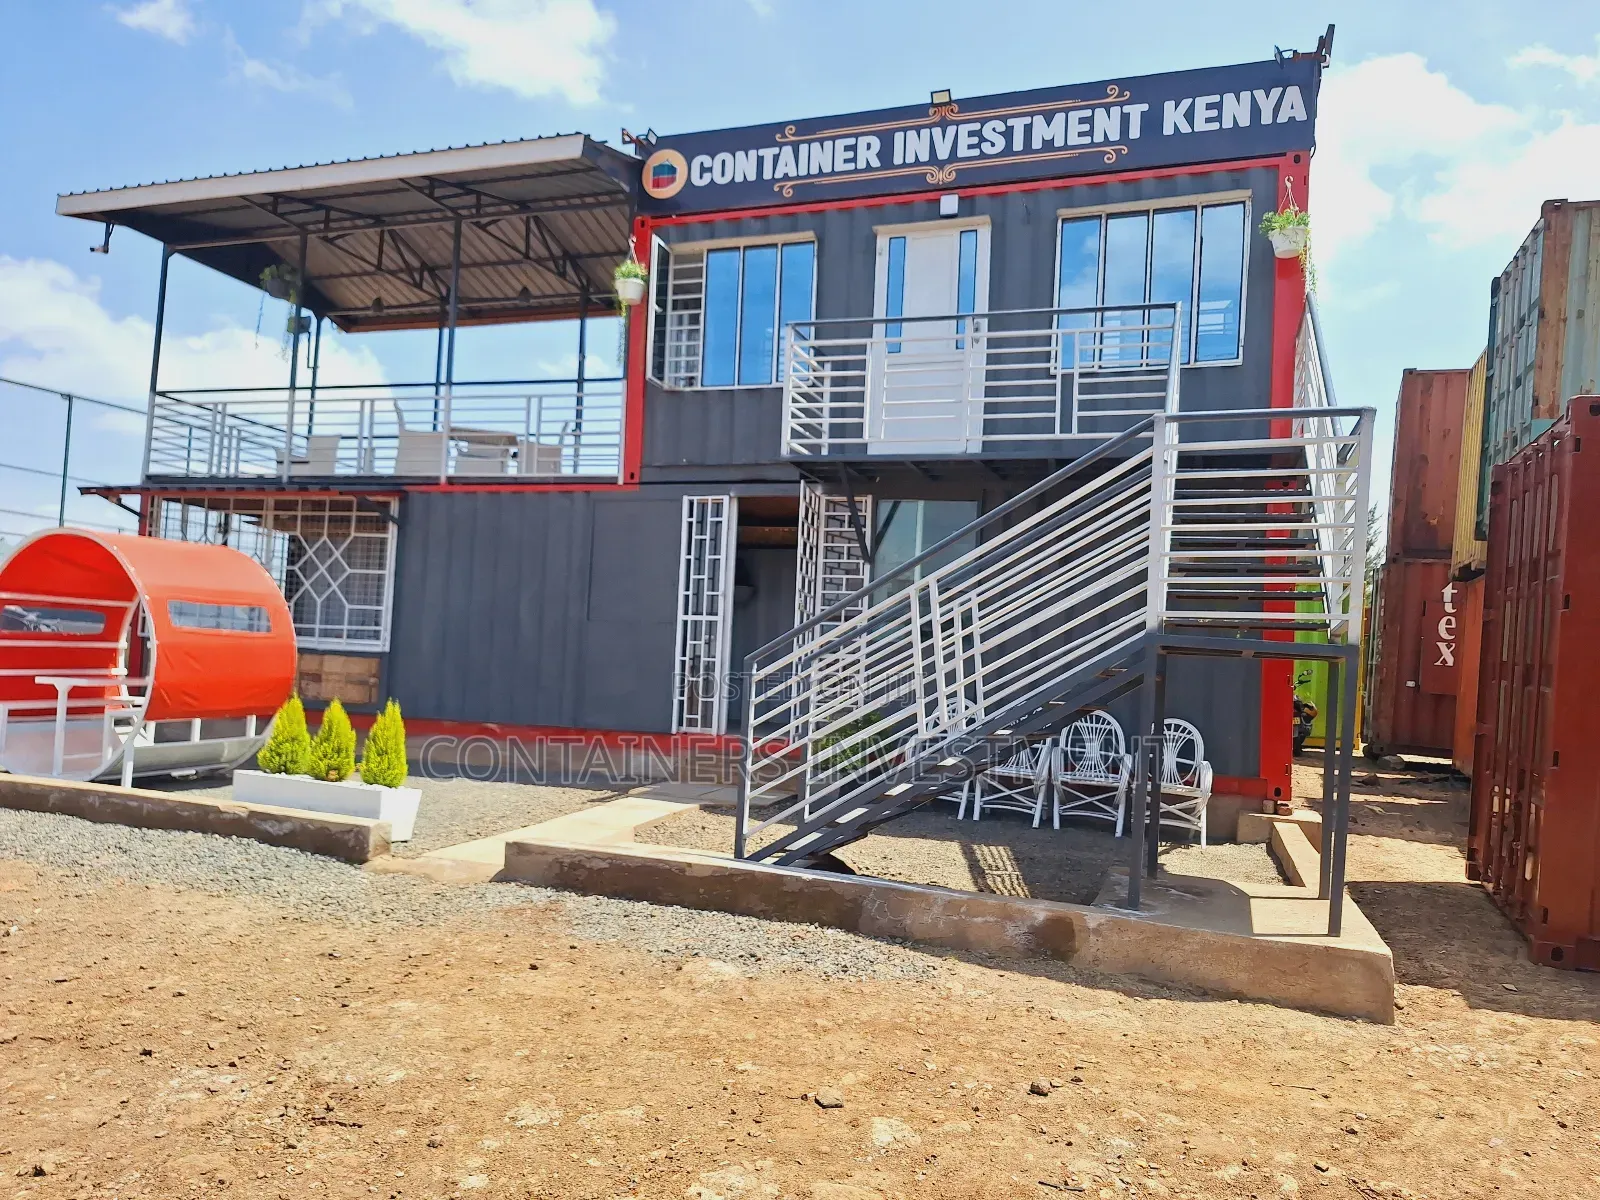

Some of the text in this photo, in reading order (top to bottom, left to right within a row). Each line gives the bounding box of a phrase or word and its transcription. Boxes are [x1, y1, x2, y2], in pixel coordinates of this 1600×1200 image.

[690, 85, 1307, 187] CONTAINER INVESTMENT KENYA
[1433, 582, 1458, 667] tex
